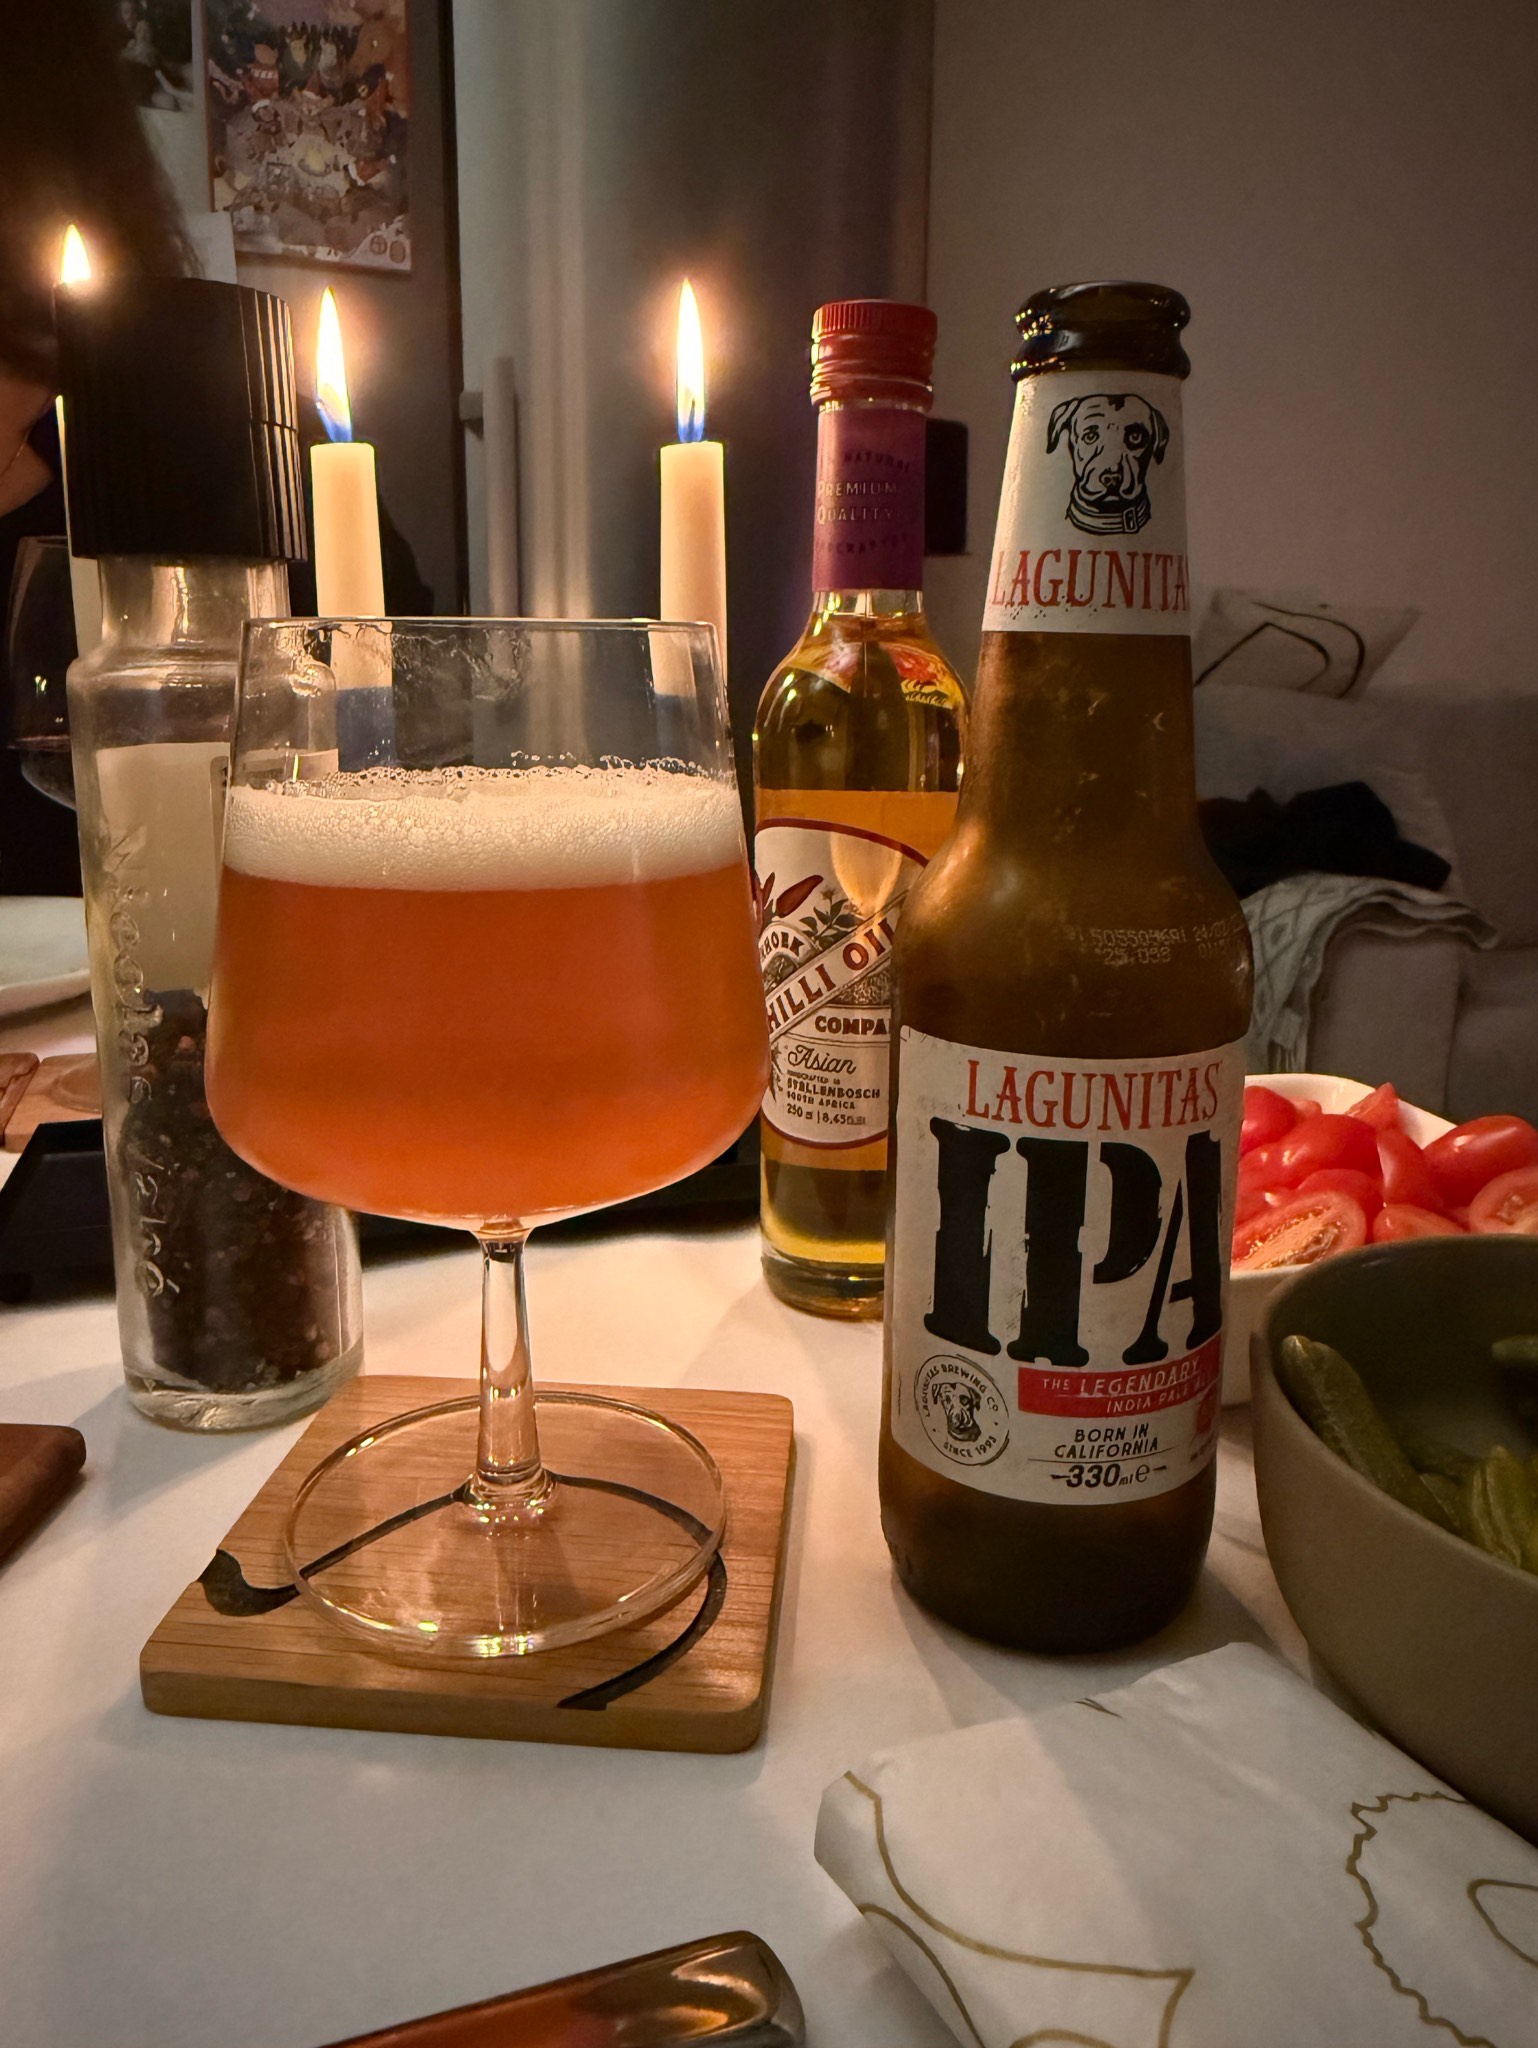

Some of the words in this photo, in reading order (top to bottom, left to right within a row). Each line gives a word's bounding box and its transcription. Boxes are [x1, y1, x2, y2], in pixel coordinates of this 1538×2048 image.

[817, 479, 898, 498] PREMIUM
[815, 503, 894, 526] QUALITY
[988, 548, 1190, 612] LAGUNITA
[764, 963, 837, 1033] HILLI
[814, 1015, 891, 1036] COMPA
[787, 1044, 857, 1075] Asian
[818, 1097, 856, 1110] AFRICA
[966, 1058, 1224, 1131] LAGUNITAS
[923, 1115, 1223, 1368] IPA
[940, 1363, 988, 1394] BREWING
[1042, 1377, 1071, 1391] THE
[1079, 1354, 1201, 1397] LEGENDARY
[1106, 1396, 1151, 1414] INDIA
[1074, 1425, 1127, 1444] BORN
[1132, 1422, 1150, 1439] IN
[942, 1441, 974, 1458] SINCE
[1053, 1437, 1159, 1460] CALIFORNIA
